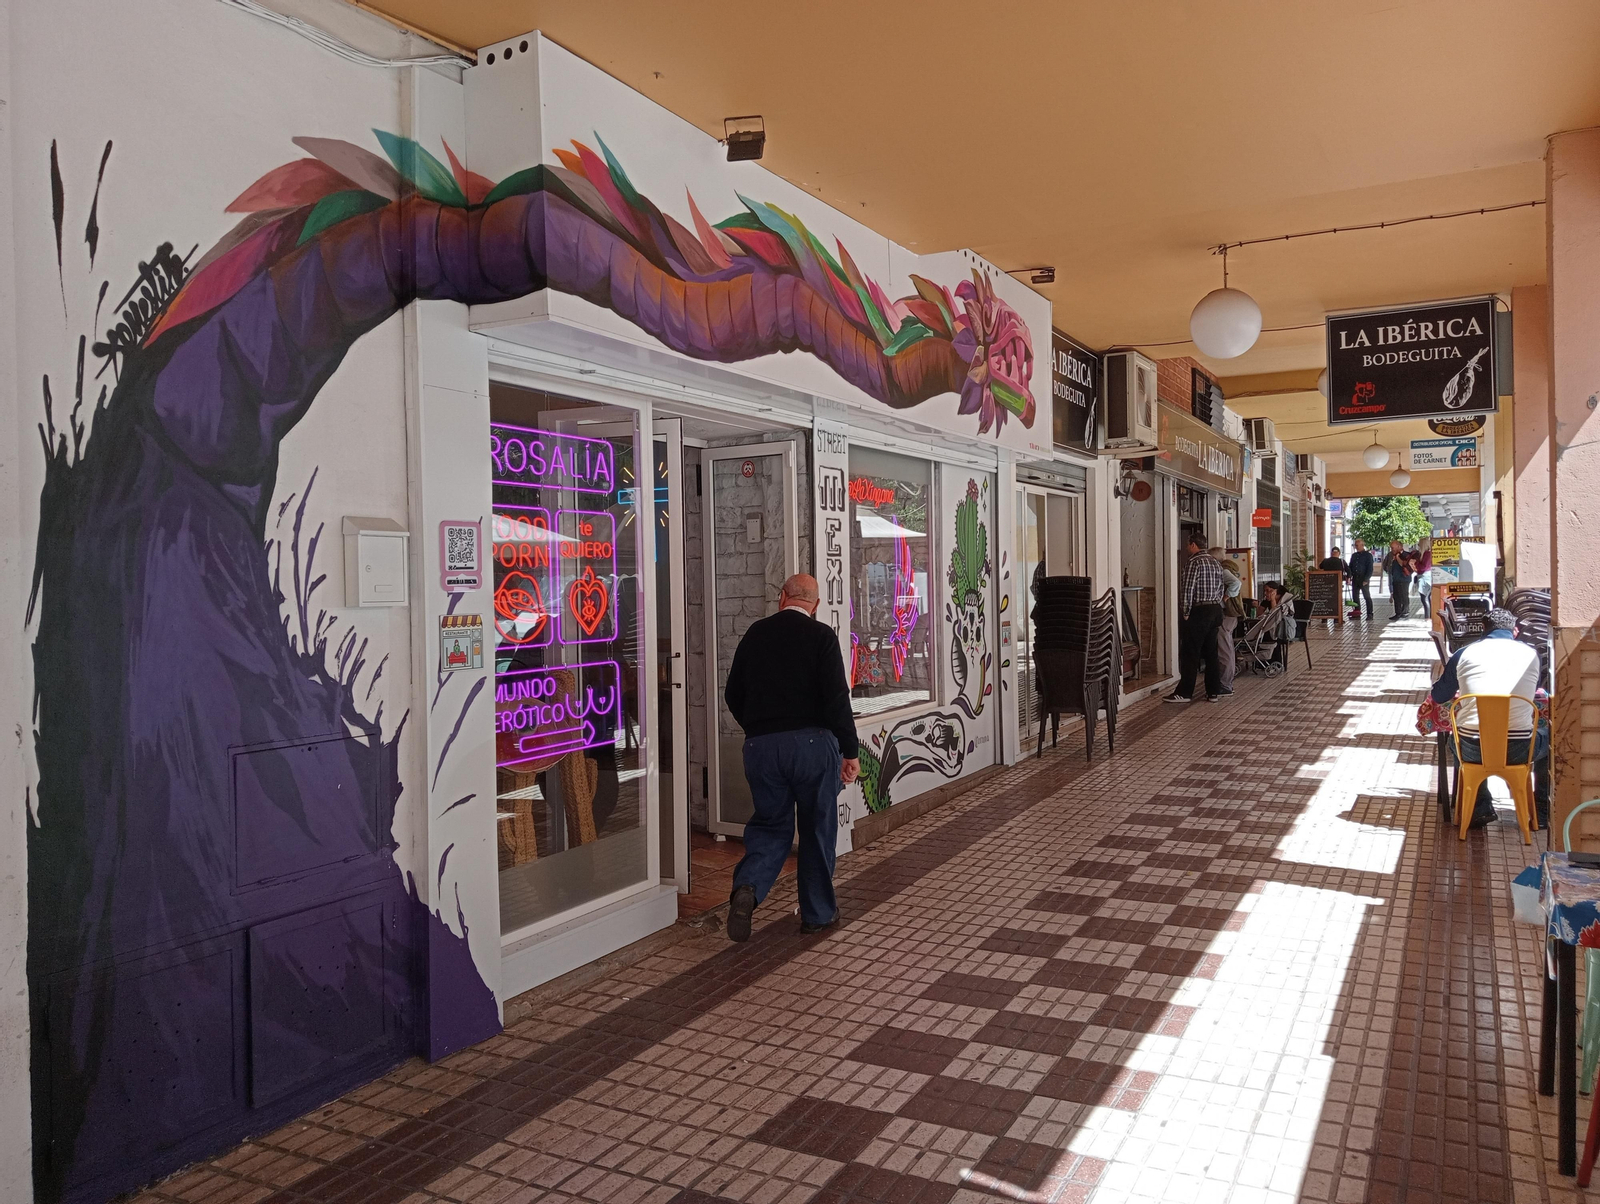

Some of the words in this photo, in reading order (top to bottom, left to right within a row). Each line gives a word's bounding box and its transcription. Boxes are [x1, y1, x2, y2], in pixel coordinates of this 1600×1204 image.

[1340, 329, 1371, 350] LA
[1377, 317, 1484, 346] IBÉRICA
[1051, 347, 1058, 372] A
[1059, 349, 1093, 389] IBÉRICA
[1362, 346, 1462, 367] BODEGUITA
[1053, 379, 1087, 408] BODEGUITA
[1339, 404, 1386, 415] Cruzcampo
[817, 428, 847, 454] STREET
[490, 434, 610, 481] ROSALÍA
[1175, 435, 1199, 459] BODEGUITA
[1198, 440, 1207, 470] LA
[1208, 442, 1234, 481] IBÉRICA
[492, 514, 548, 541] OOD
[579, 519, 594, 537] te
[560, 540, 613, 559] QUIERO
